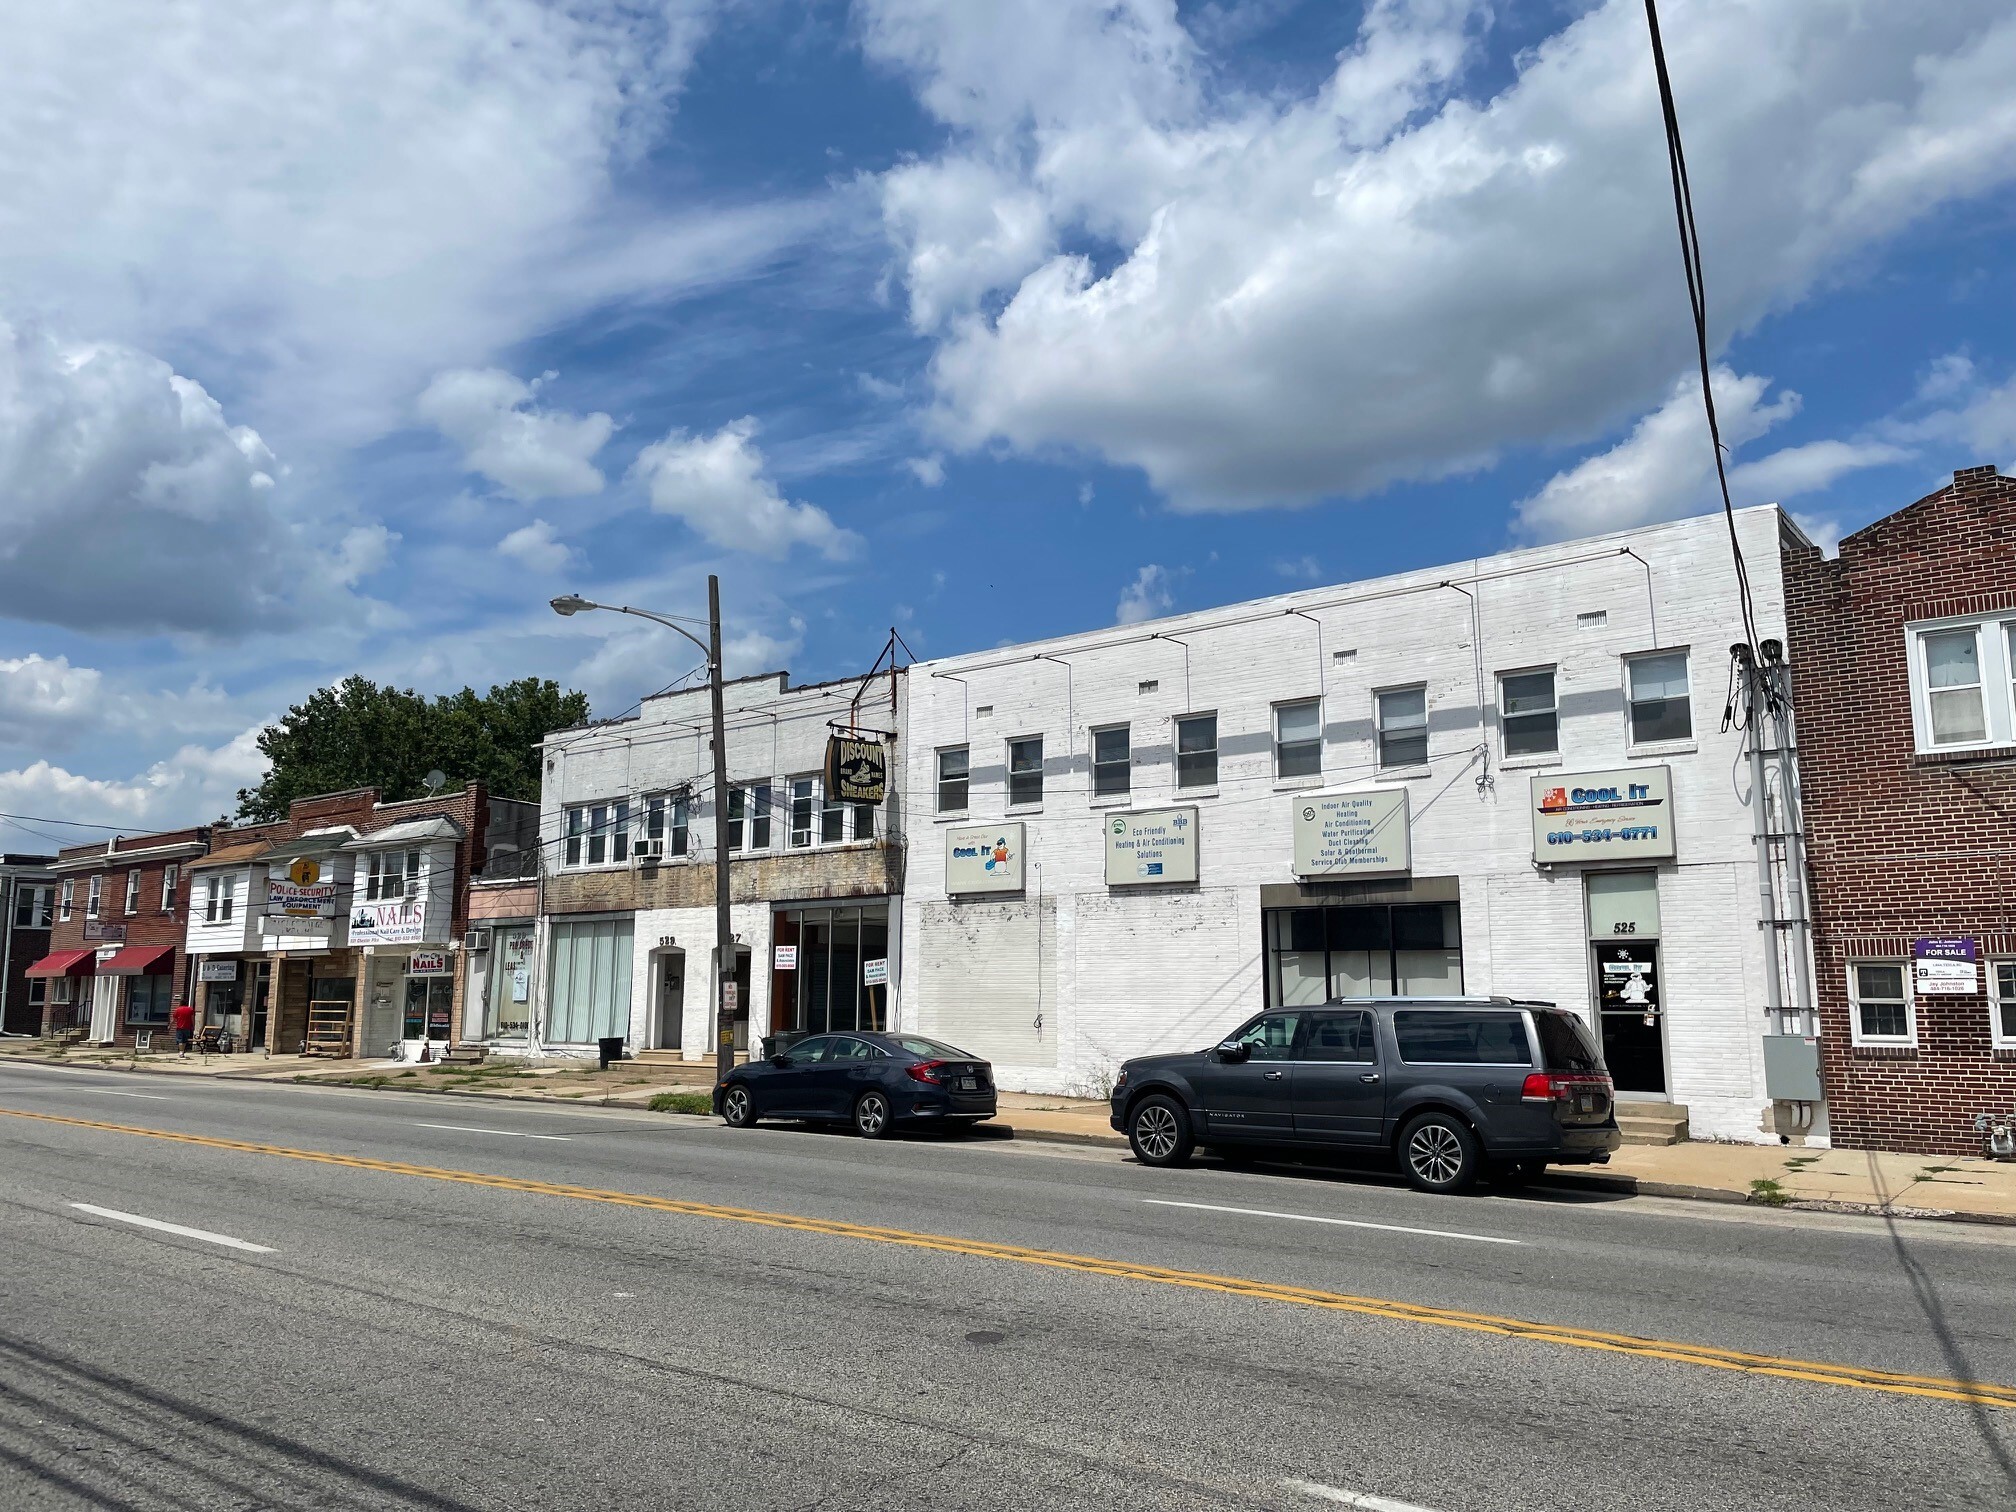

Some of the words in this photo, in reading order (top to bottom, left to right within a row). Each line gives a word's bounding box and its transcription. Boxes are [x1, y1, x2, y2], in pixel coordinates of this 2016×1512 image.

[841, 740, 883, 770] DISCOUNT
[841, 779, 884, 801] SNEAKERS
[1351, 800, 1372, 808] Quality
[1335, 819, 1371, 828] Conditioning
[1133, 828, 1142, 836] Eco
[1144, 826, 1166, 836] Friendly
[1322, 830, 1338, 838] Water
[1341, 829, 1375, 837] Purification
[1116, 840, 1134, 850] Heating
[1136, 839, 1141, 848] &
[1152, 836, 1185, 848] Conditioning
[1343, 838, 1369, 846] Cleaning
[1137, 850, 1163, 859] Solutions
[1345, 847, 1378, 856] Geothermal
[1349, 856, 1388, 865] Memberships
[286, 896, 335, 905] ENFORCEMENT
[282, 902, 321, 910] EQUIPMENT
[376, 904, 422, 926] NAILS
[353, 929, 379, 937] Professional
[406, 926, 422, 935] Design
[1613, 922, 1635, 934] 525
[413, 957, 443, 969] NAILS
